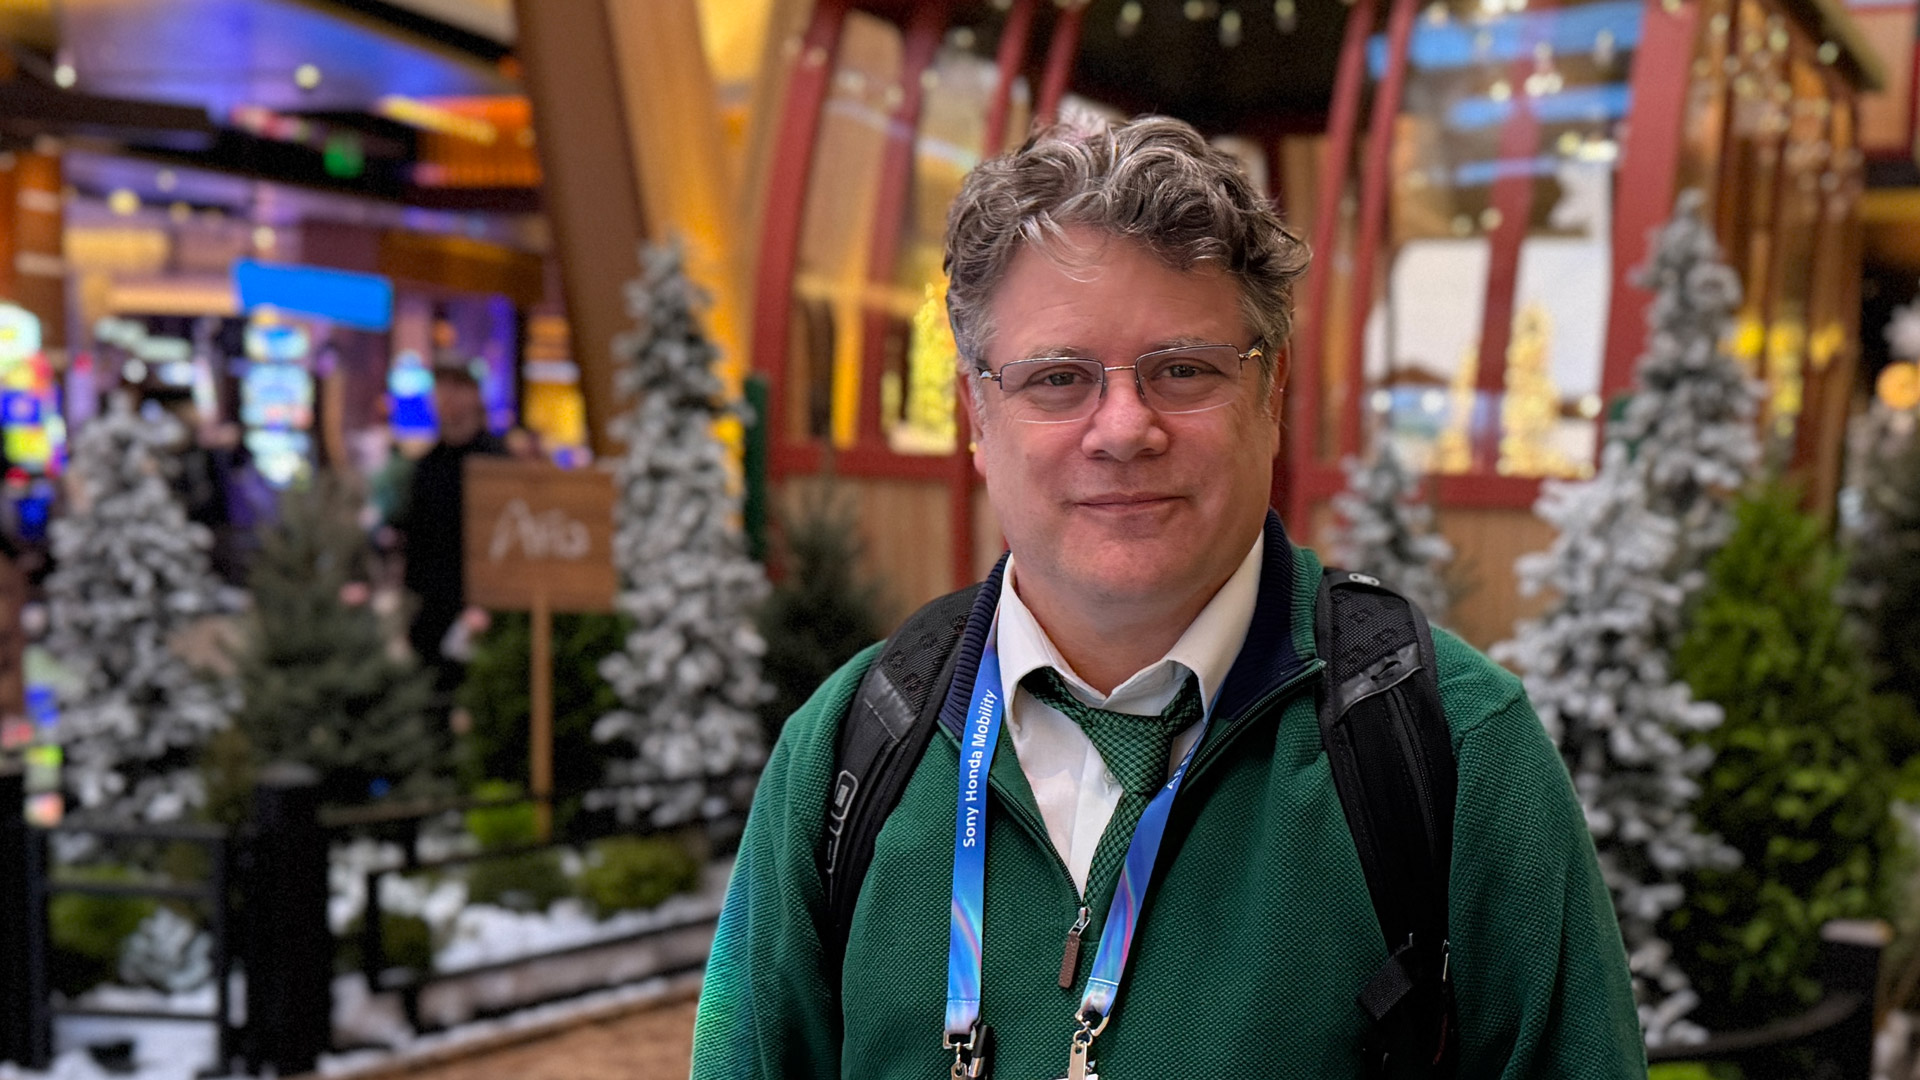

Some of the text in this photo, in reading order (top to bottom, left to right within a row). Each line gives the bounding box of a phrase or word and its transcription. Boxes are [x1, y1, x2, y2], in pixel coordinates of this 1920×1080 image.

[963, 688, 998, 848] Sony Honda Mobility
